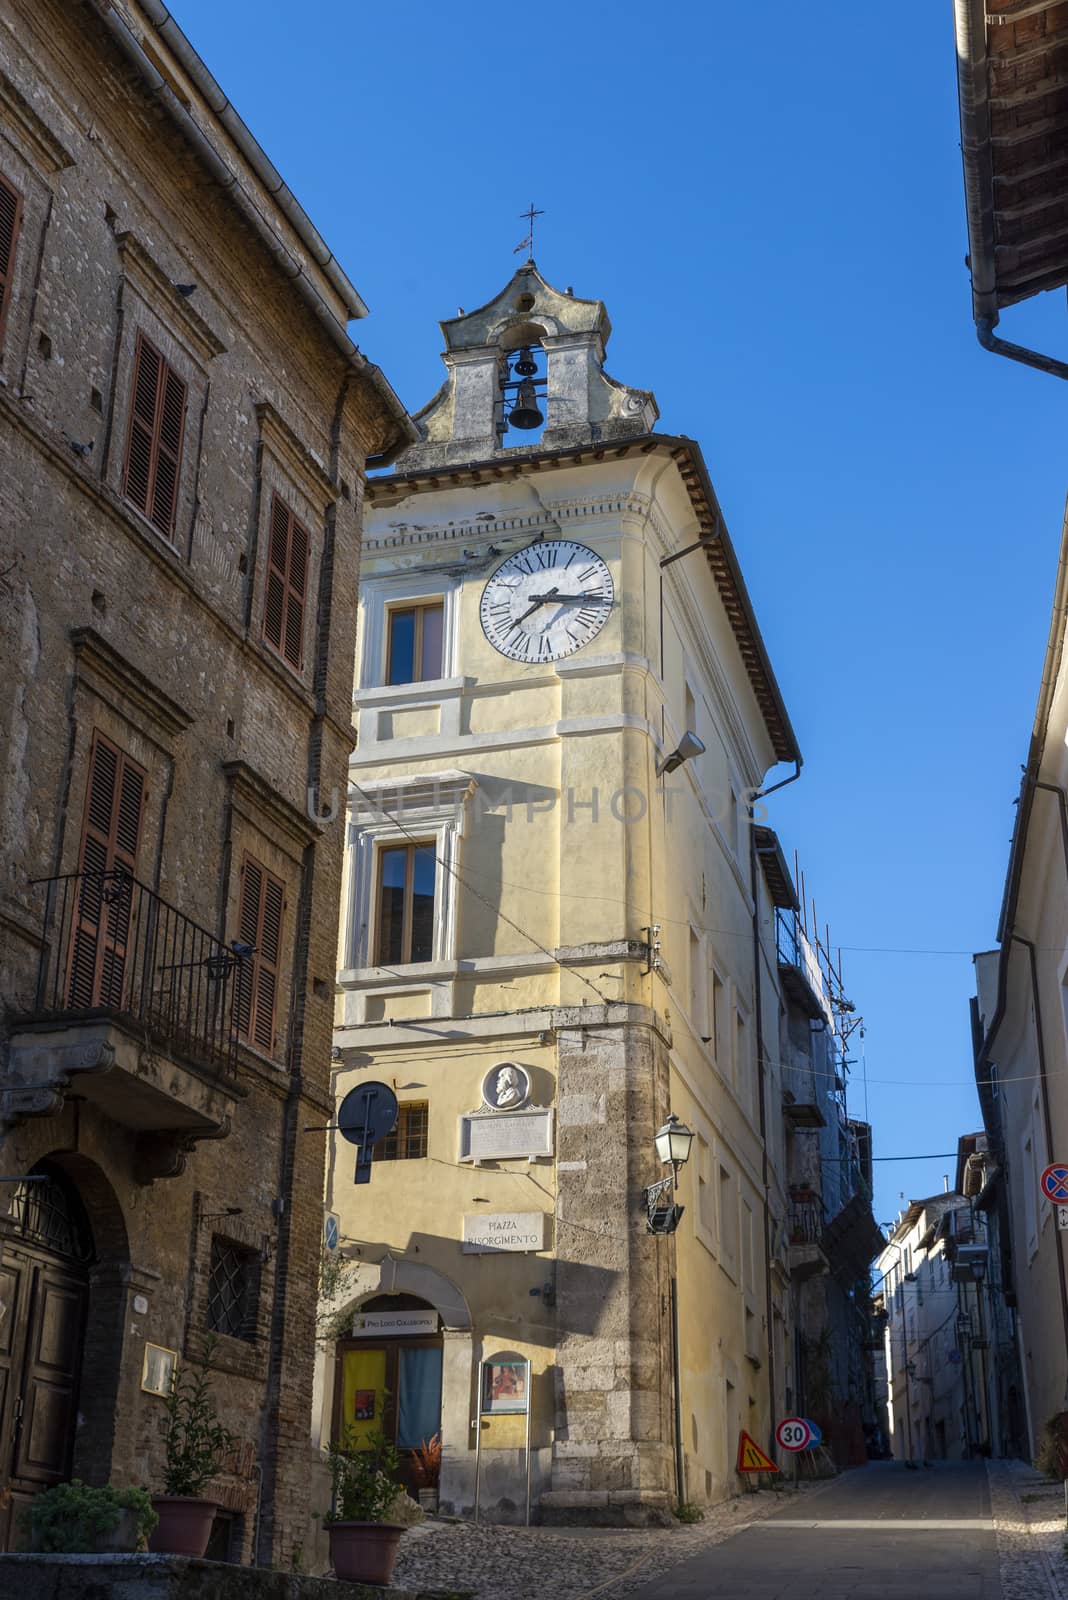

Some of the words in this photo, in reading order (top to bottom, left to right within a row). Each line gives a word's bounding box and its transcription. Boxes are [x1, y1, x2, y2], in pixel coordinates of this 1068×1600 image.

[536, 549, 558, 569] XII
[577, 566, 598, 582] II
[488, 1220, 517, 1231] PIAZZA
[467, 1234, 538, 1247] RISORGIMENTO
[783, 1426, 804, 1443] 30
